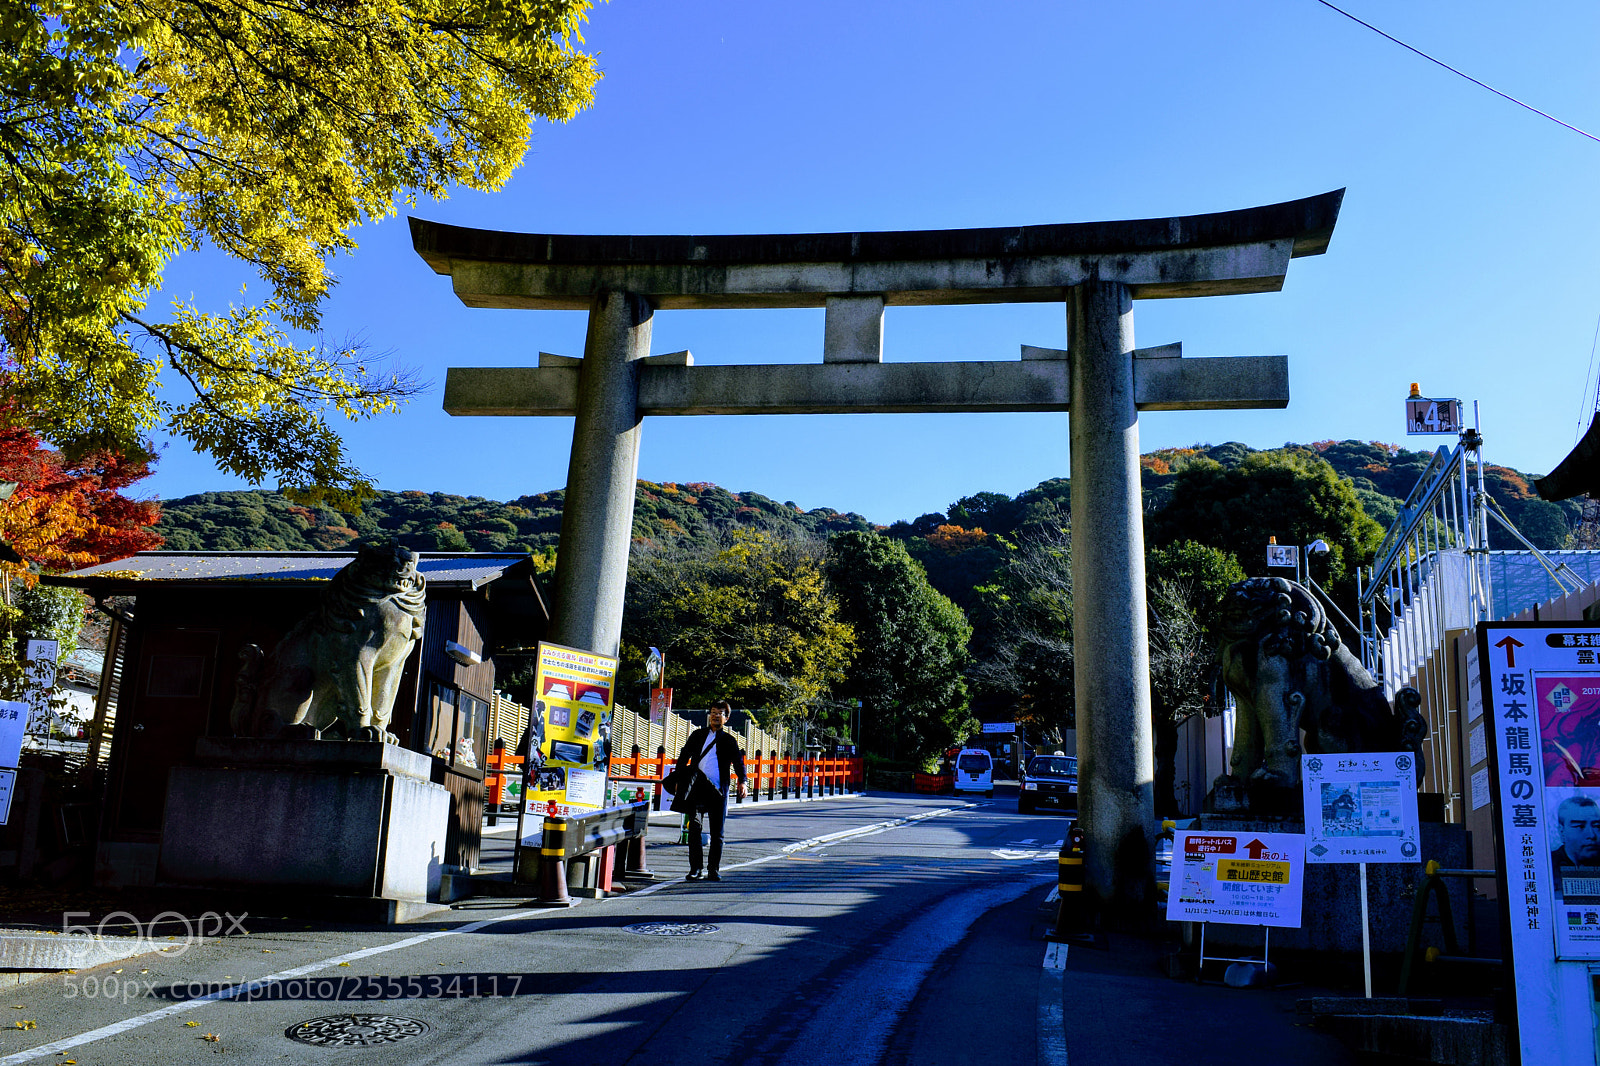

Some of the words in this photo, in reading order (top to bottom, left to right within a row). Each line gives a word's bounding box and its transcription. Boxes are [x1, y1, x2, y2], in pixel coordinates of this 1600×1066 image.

[1501, 673, 1537, 828] 坂本龍馬の墓
[1338, 759, 1380, 768] お知らせ
[529, 802, 569, 816] 本日時延長
[1261, 852, 1289, 861] 坂の上
[1222, 882, 1283, 894] 開館しています
[1520, 833, 1541, 930] 京都霊山護國神社
